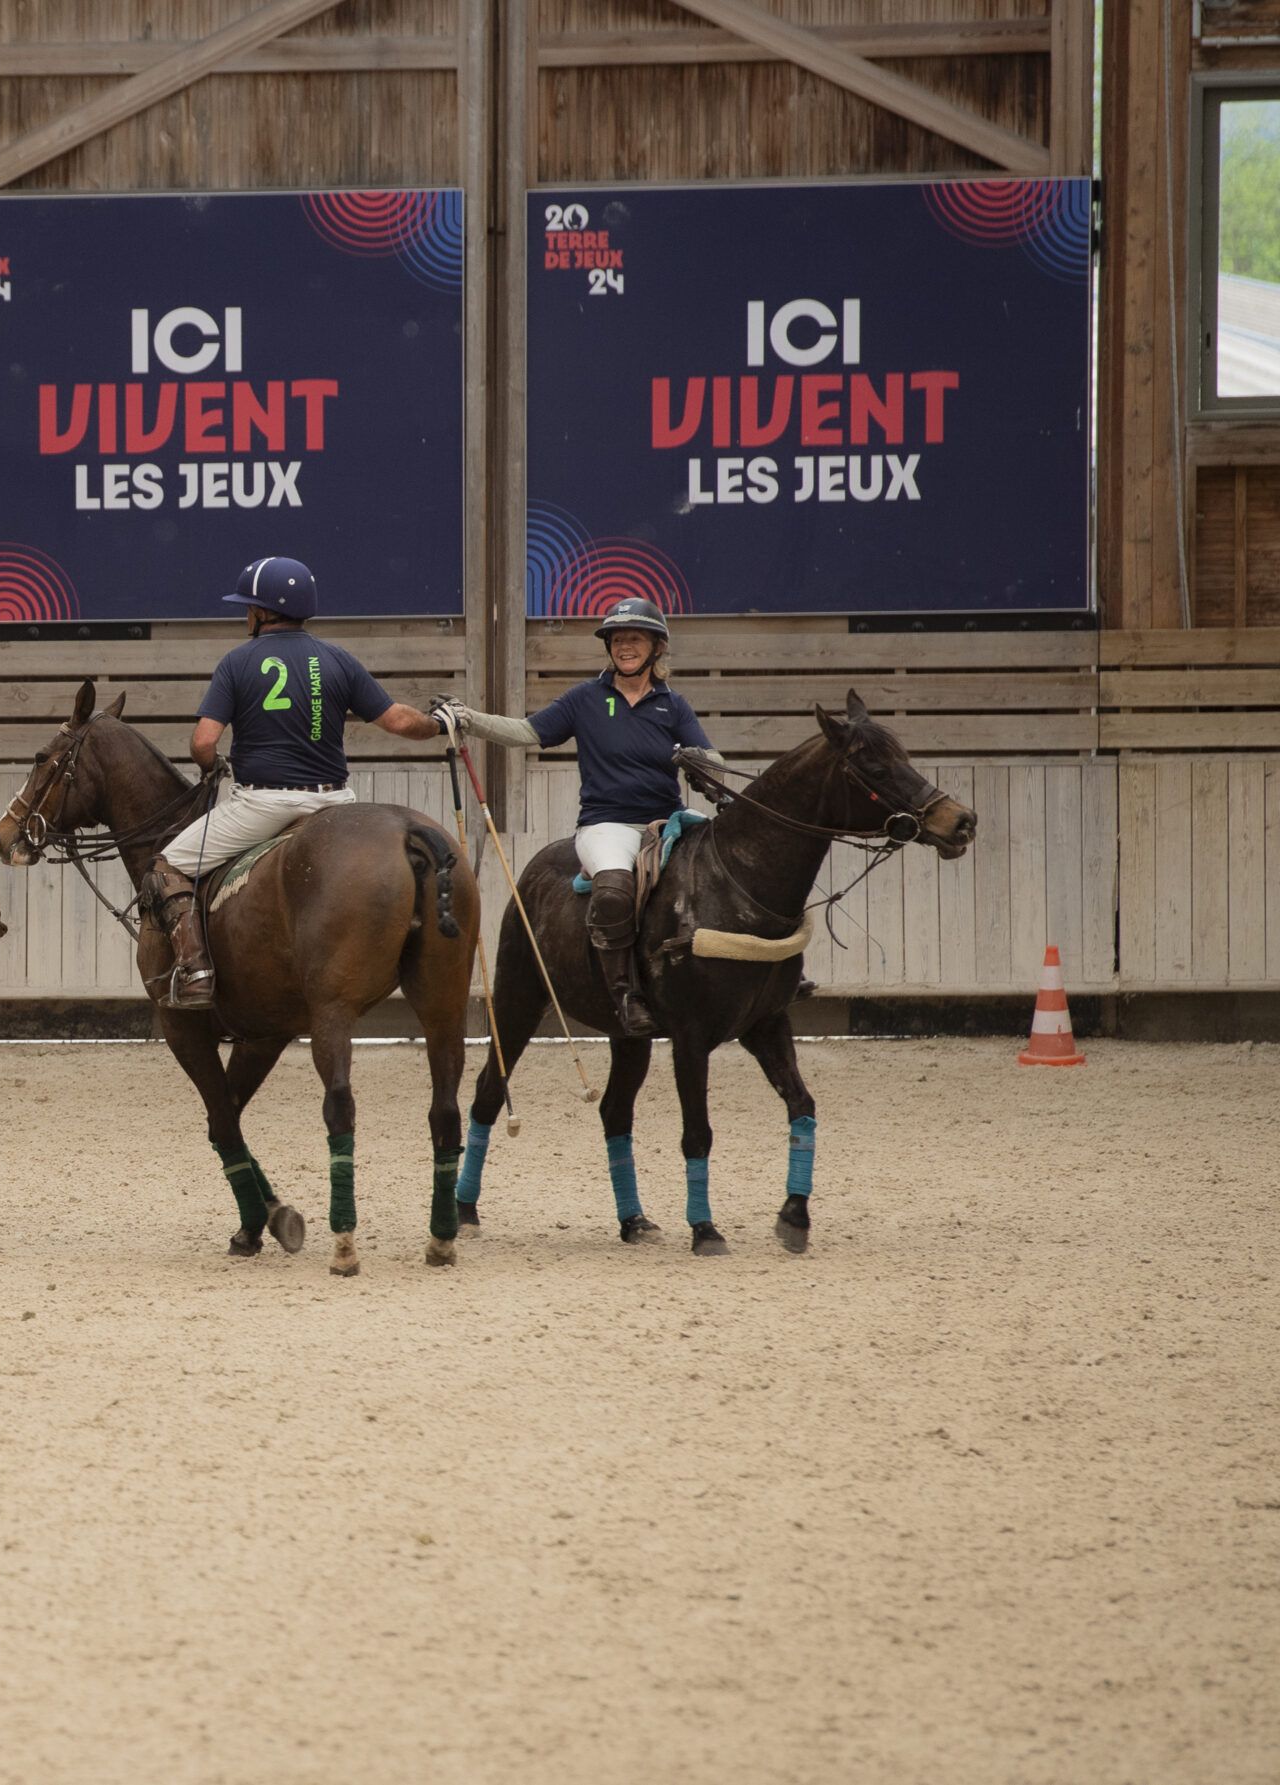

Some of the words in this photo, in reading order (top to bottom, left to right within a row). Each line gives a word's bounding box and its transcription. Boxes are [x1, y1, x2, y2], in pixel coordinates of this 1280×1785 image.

[545, 204, 589, 231] 20
[545, 231, 609, 250] TERRE
[545, 251, 570, 269] DE
[574, 250, 624, 269] JEUX
[588, 268, 624, 295] 24
[131, 306, 242, 374] ICI
[747, 298, 860, 367] ICI
[38, 378, 338, 455] VIVENT
[652, 370, 959, 449] VIVENT
[75, 463, 164, 510] LES
[178, 461, 302, 509] JEUX
[689, 456, 779, 504] LES
[794, 454, 921, 502] JEUX
[261, 657, 291, 710] 2
[308, 657, 321, 695] MARTIN
[310, 698, 322, 741] GRANGE
[605, 697, 615, 716] 1
